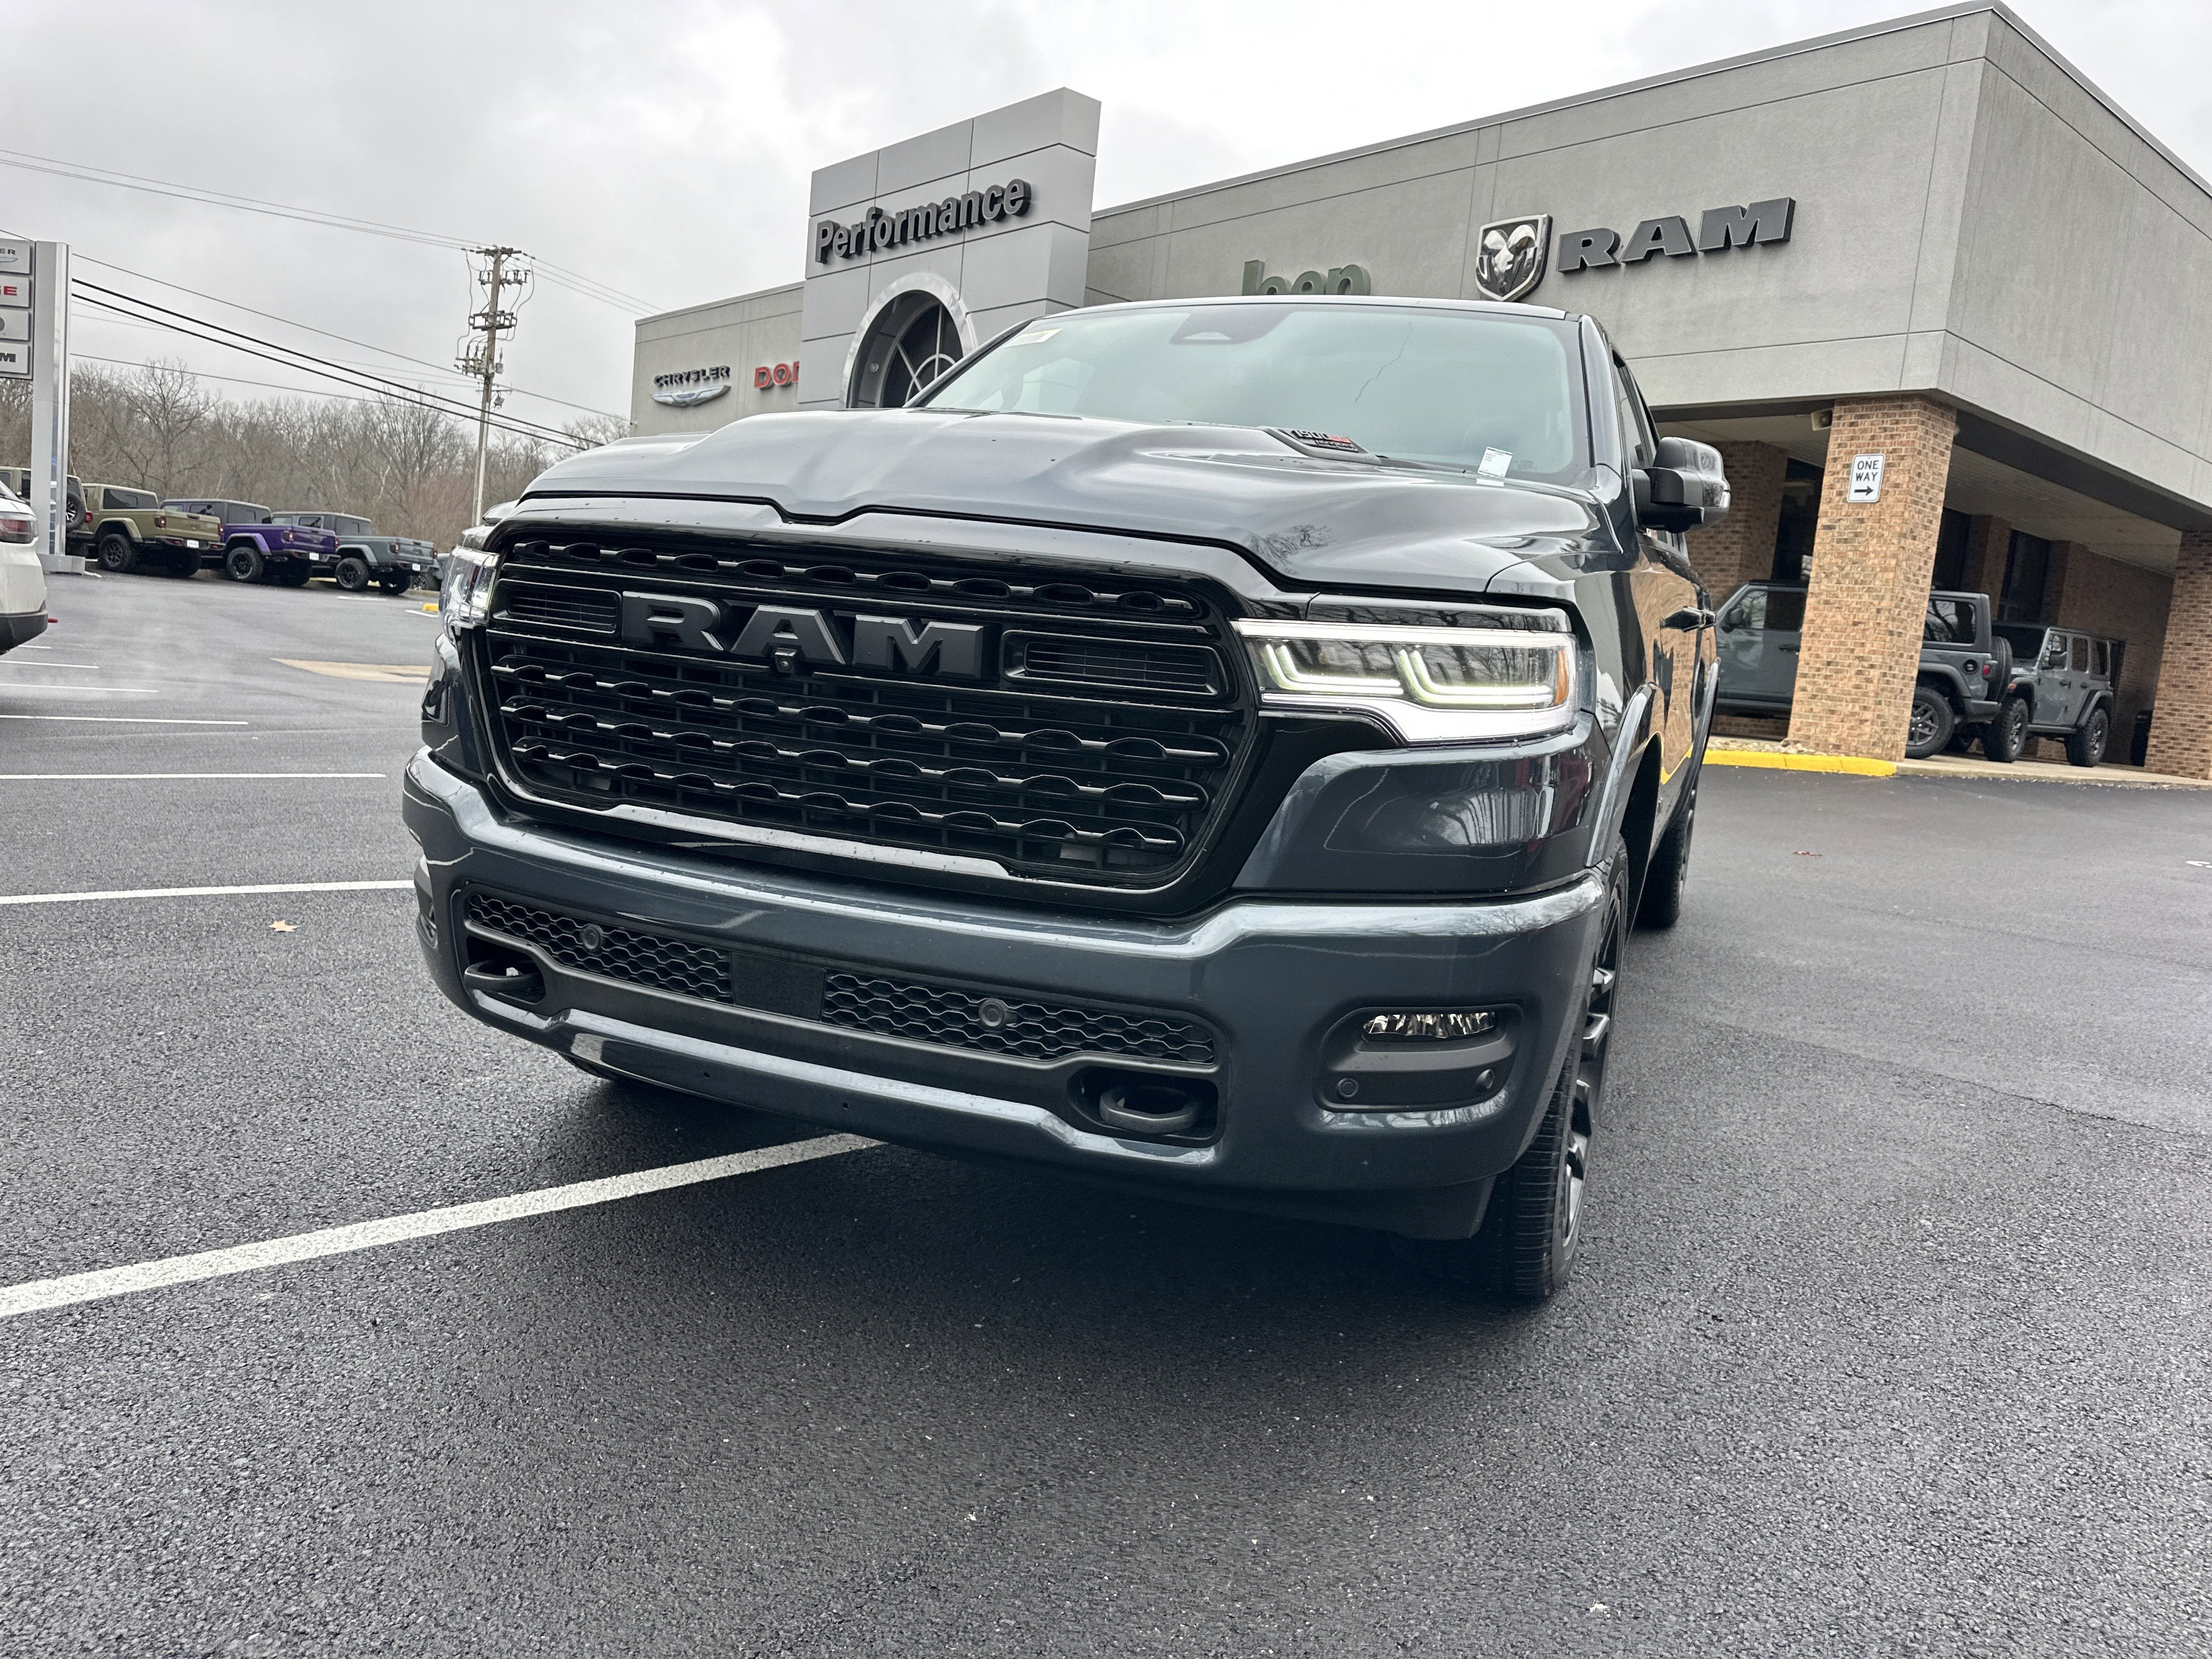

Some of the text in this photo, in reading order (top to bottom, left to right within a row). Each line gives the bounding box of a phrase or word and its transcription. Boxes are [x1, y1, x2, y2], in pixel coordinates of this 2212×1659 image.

[815, 178, 1032, 264] Performance
[1556, 197, 1796, 273] RAM
[654, 365, 731, 387] CHRYSLER
[1855, 472, 1878, 482] WAY
[1857, 460, 1880, 470] ONE
[622, 590, 984, 680] RAM
